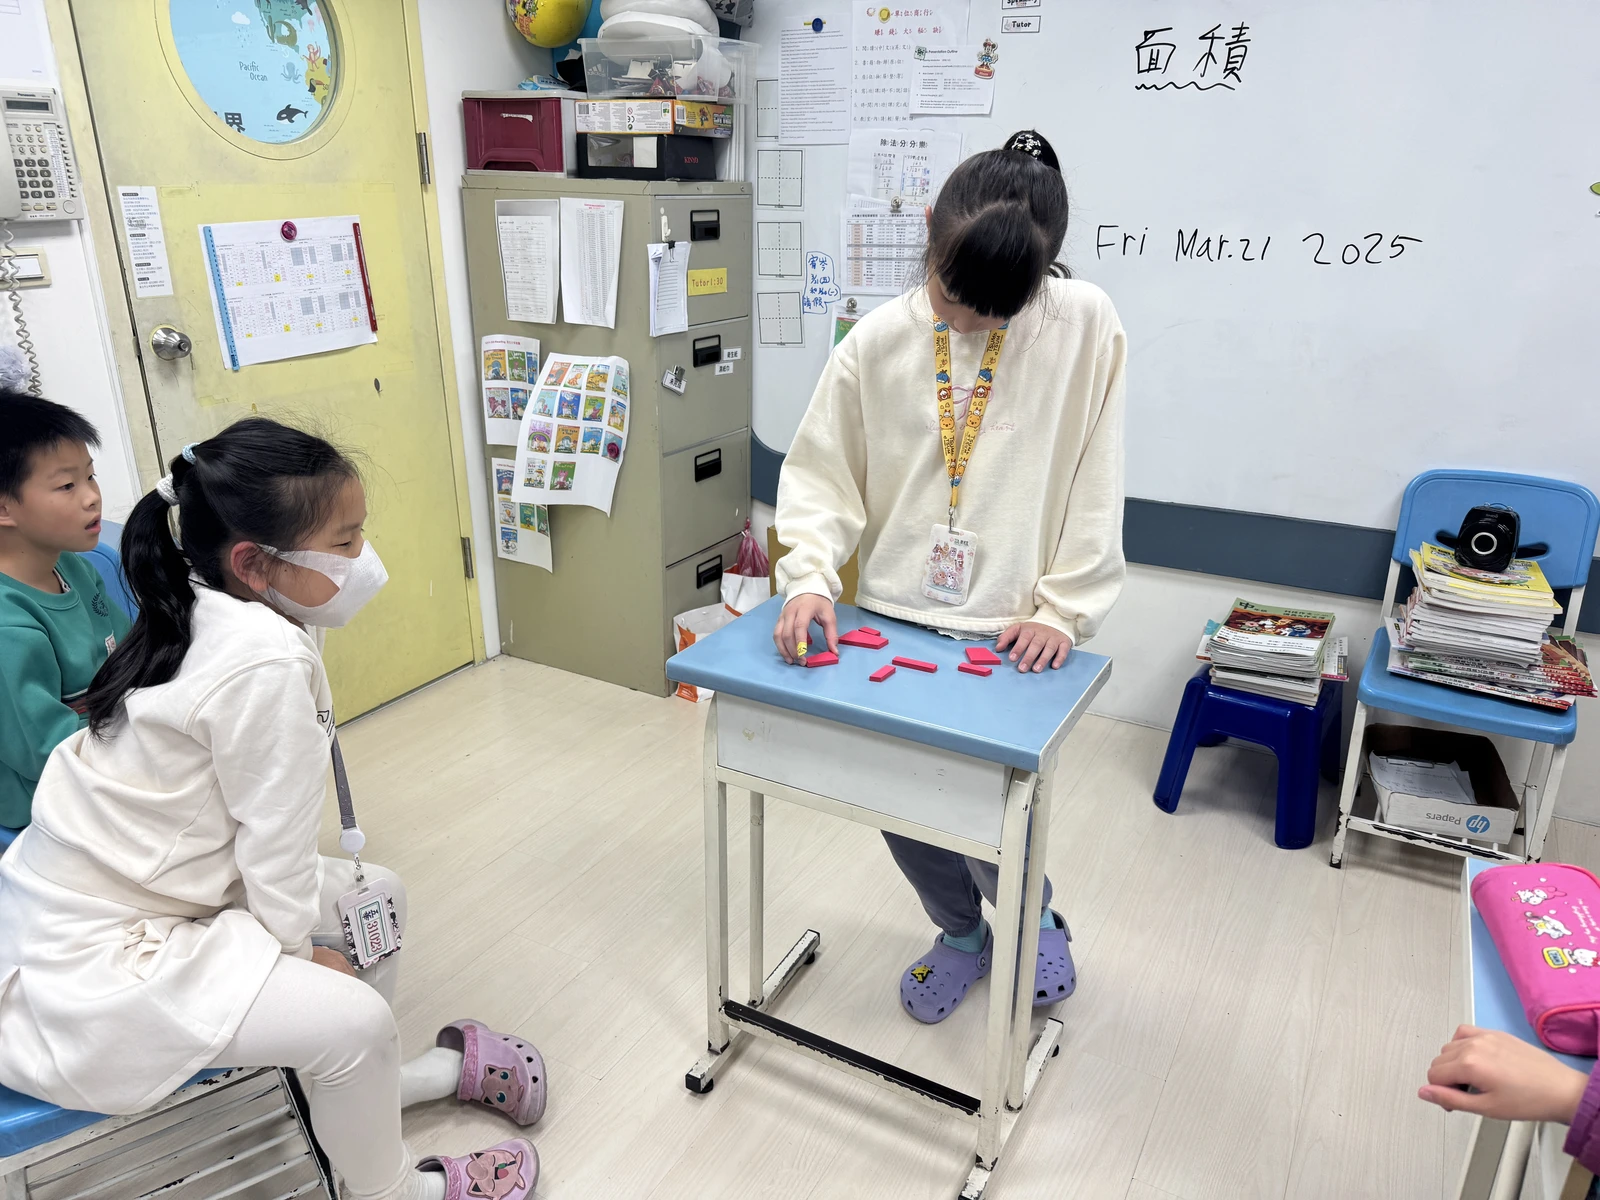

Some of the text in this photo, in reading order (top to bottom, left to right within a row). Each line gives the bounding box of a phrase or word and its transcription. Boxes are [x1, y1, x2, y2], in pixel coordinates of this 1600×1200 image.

[1135, 21, 1251, 83] 面積
[239, 61, 259, 72] Pacific
[250, 72, 268, 82] Ocean
[1096, 225, 1149, 260] Fri
[1302, 233, 1423, 265] 2025
[1425, 813, 1462, 826] Papers
[1467, 815, 1489, 834] hp
[366, 921, 382, 952] 31023
